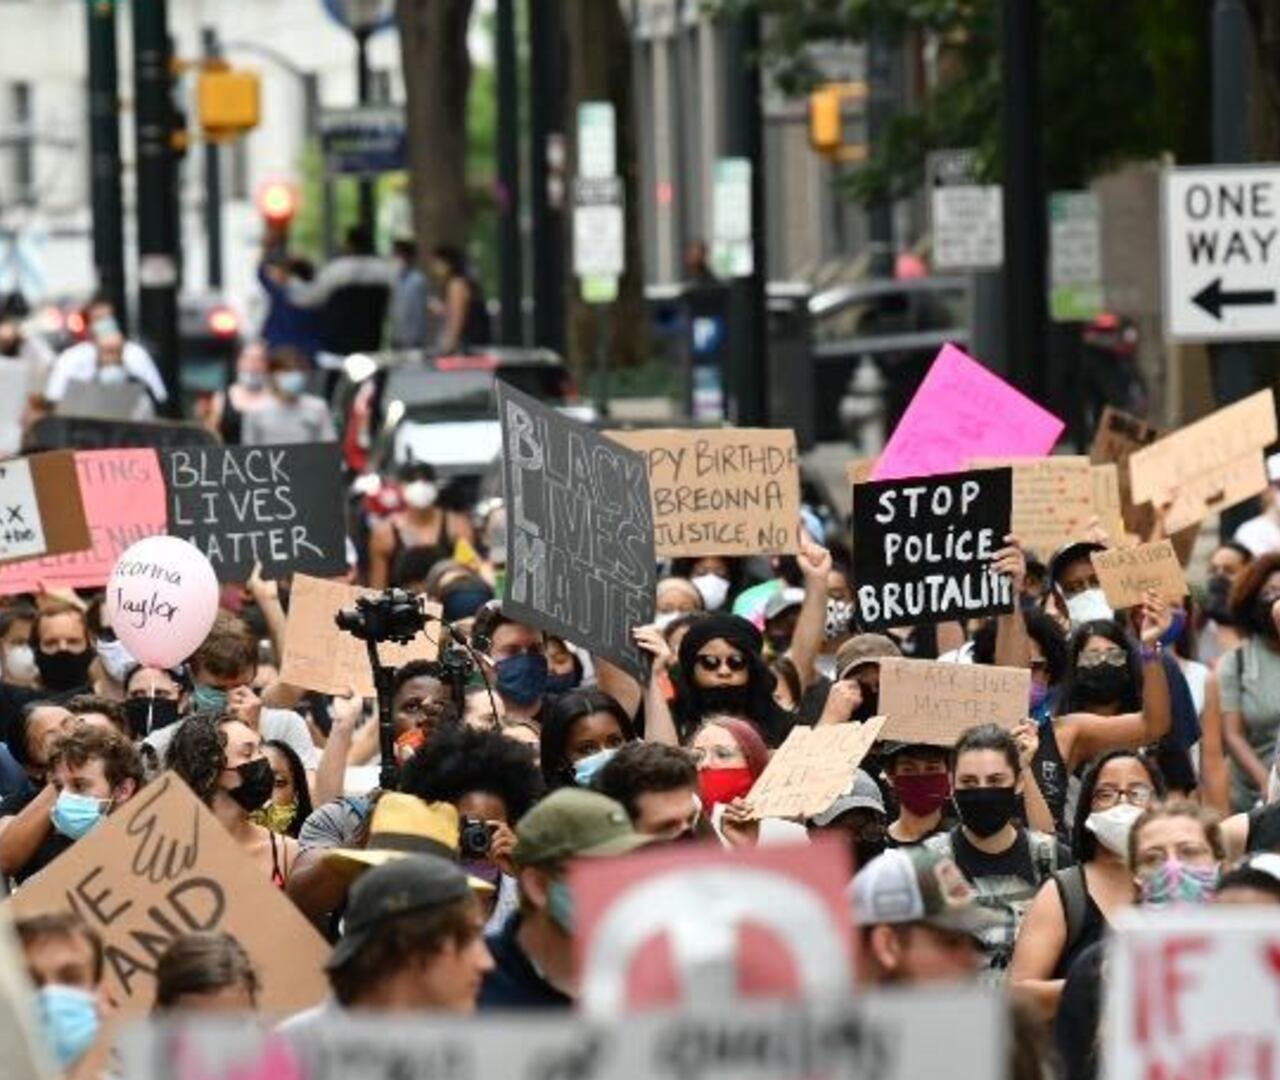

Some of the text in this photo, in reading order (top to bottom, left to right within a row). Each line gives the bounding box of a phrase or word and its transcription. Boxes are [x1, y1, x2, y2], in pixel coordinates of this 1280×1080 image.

[1185, 183, 1274, 220] ONE
[1188, 229, 1278, 265] WAY
[171, 450, 291, 488] BLACK
[7, 504, 25, 525] X
[174, 486, 297, 525] LIVES
[654, 480, 784, 516] BREONNA
[874, 480, 981, 524] STOP
[758, 521, 788, 547] NO
[1132, 936, 1210, 1046] IF
